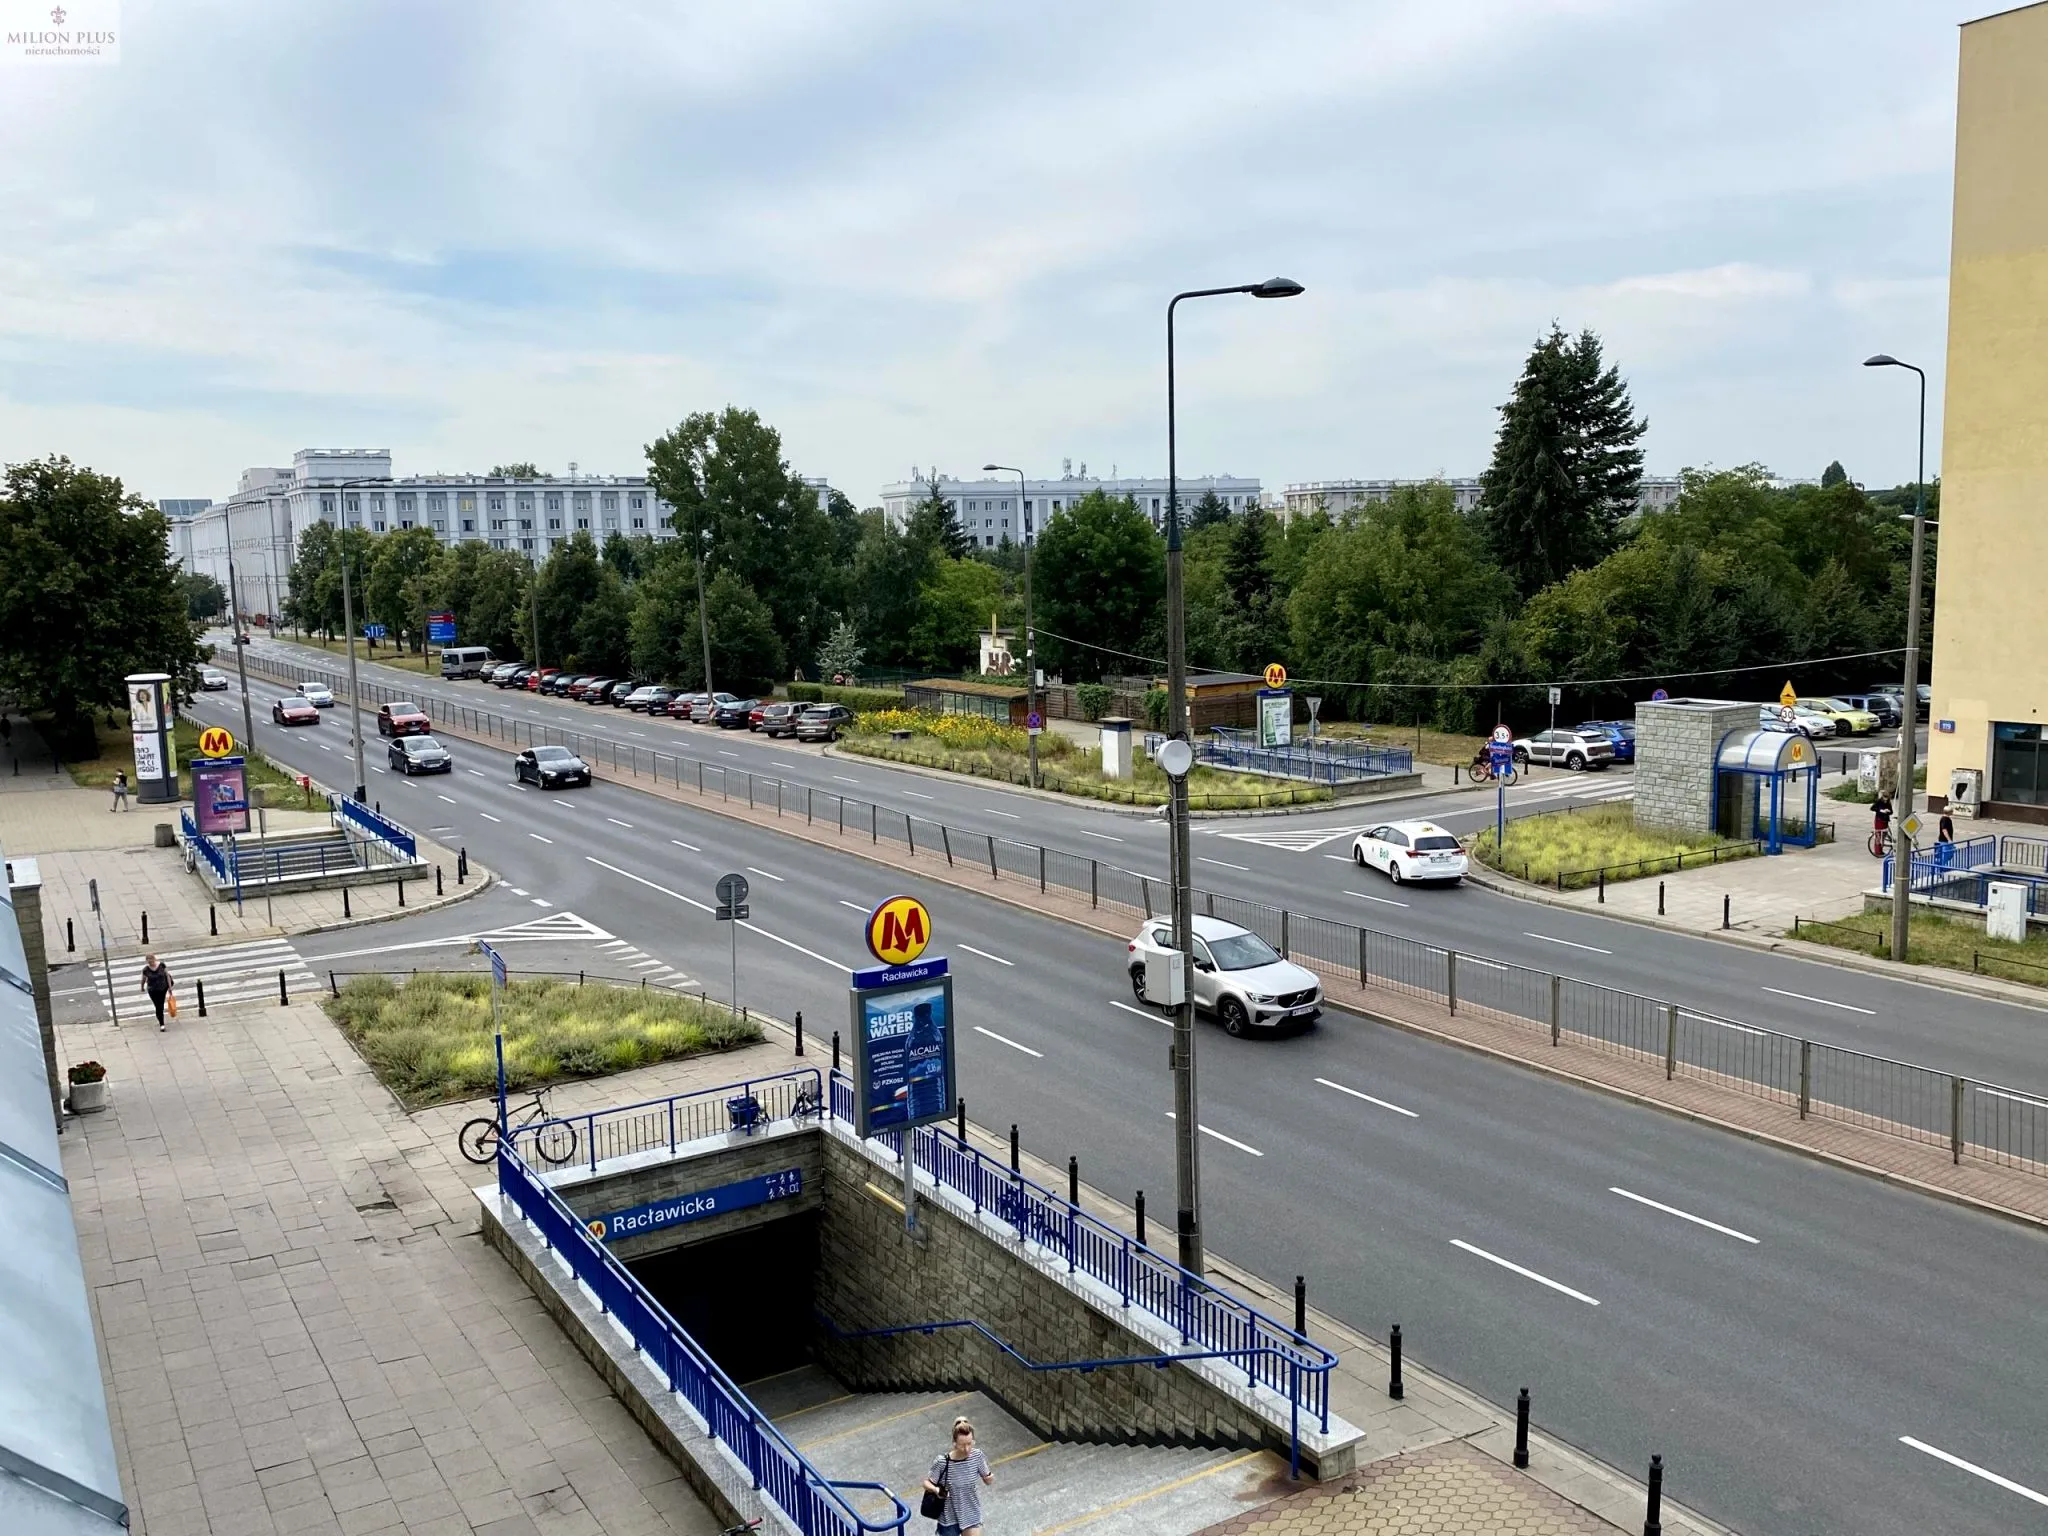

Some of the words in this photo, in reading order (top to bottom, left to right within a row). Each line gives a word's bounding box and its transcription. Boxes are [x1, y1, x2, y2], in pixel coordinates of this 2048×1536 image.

[1782, 710, 1793, 719] 30
[881, 907, 925, 954] M
[882, 967, 928, 982] Racławicka
[870, 1011, 913, 1029] SUPER
[869, 1022, 914, 1039] WATER
[613, 1197, 715, 1233] Racławicka
